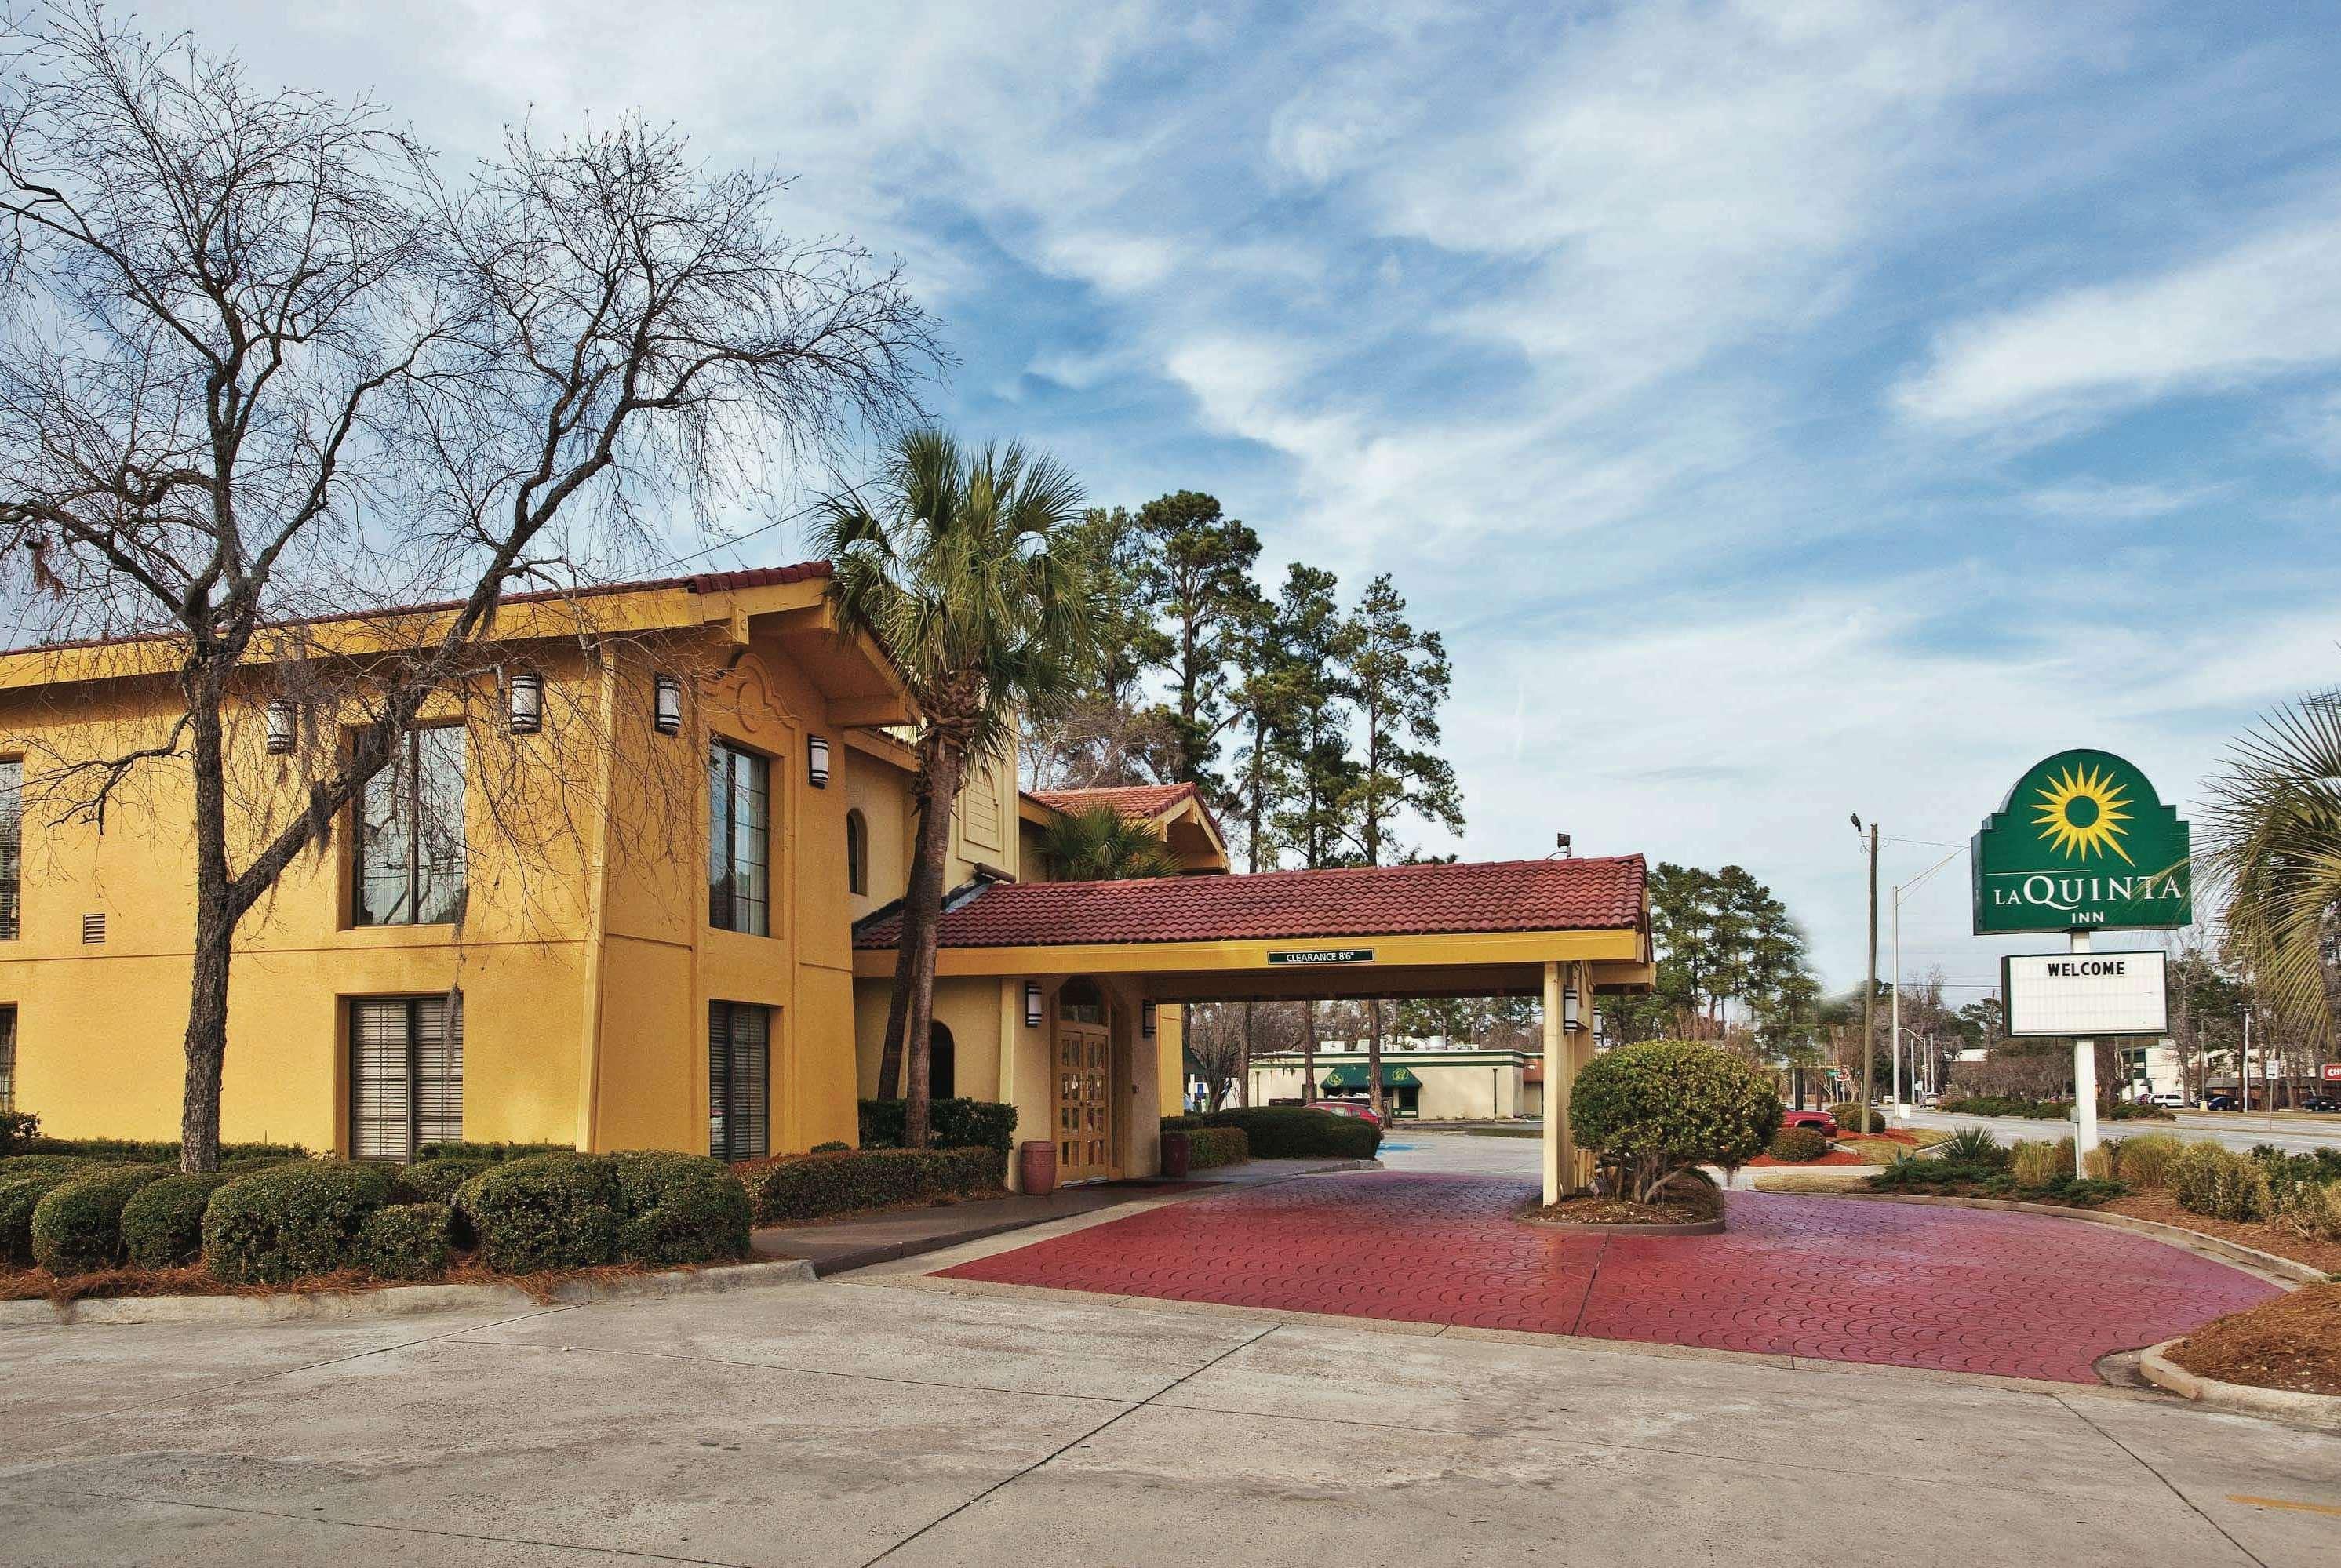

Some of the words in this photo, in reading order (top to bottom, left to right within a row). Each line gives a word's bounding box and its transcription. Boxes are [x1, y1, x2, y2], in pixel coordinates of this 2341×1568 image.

[1994, 890, 2022, 905] LA
[2023, 875, 2183, 911] QUINTA
[2072, 911, 2104, 924] INN
[1286, 953, 1336, 962] CLEARANCE
[2048, 962, 2124, 977] WELCOME
